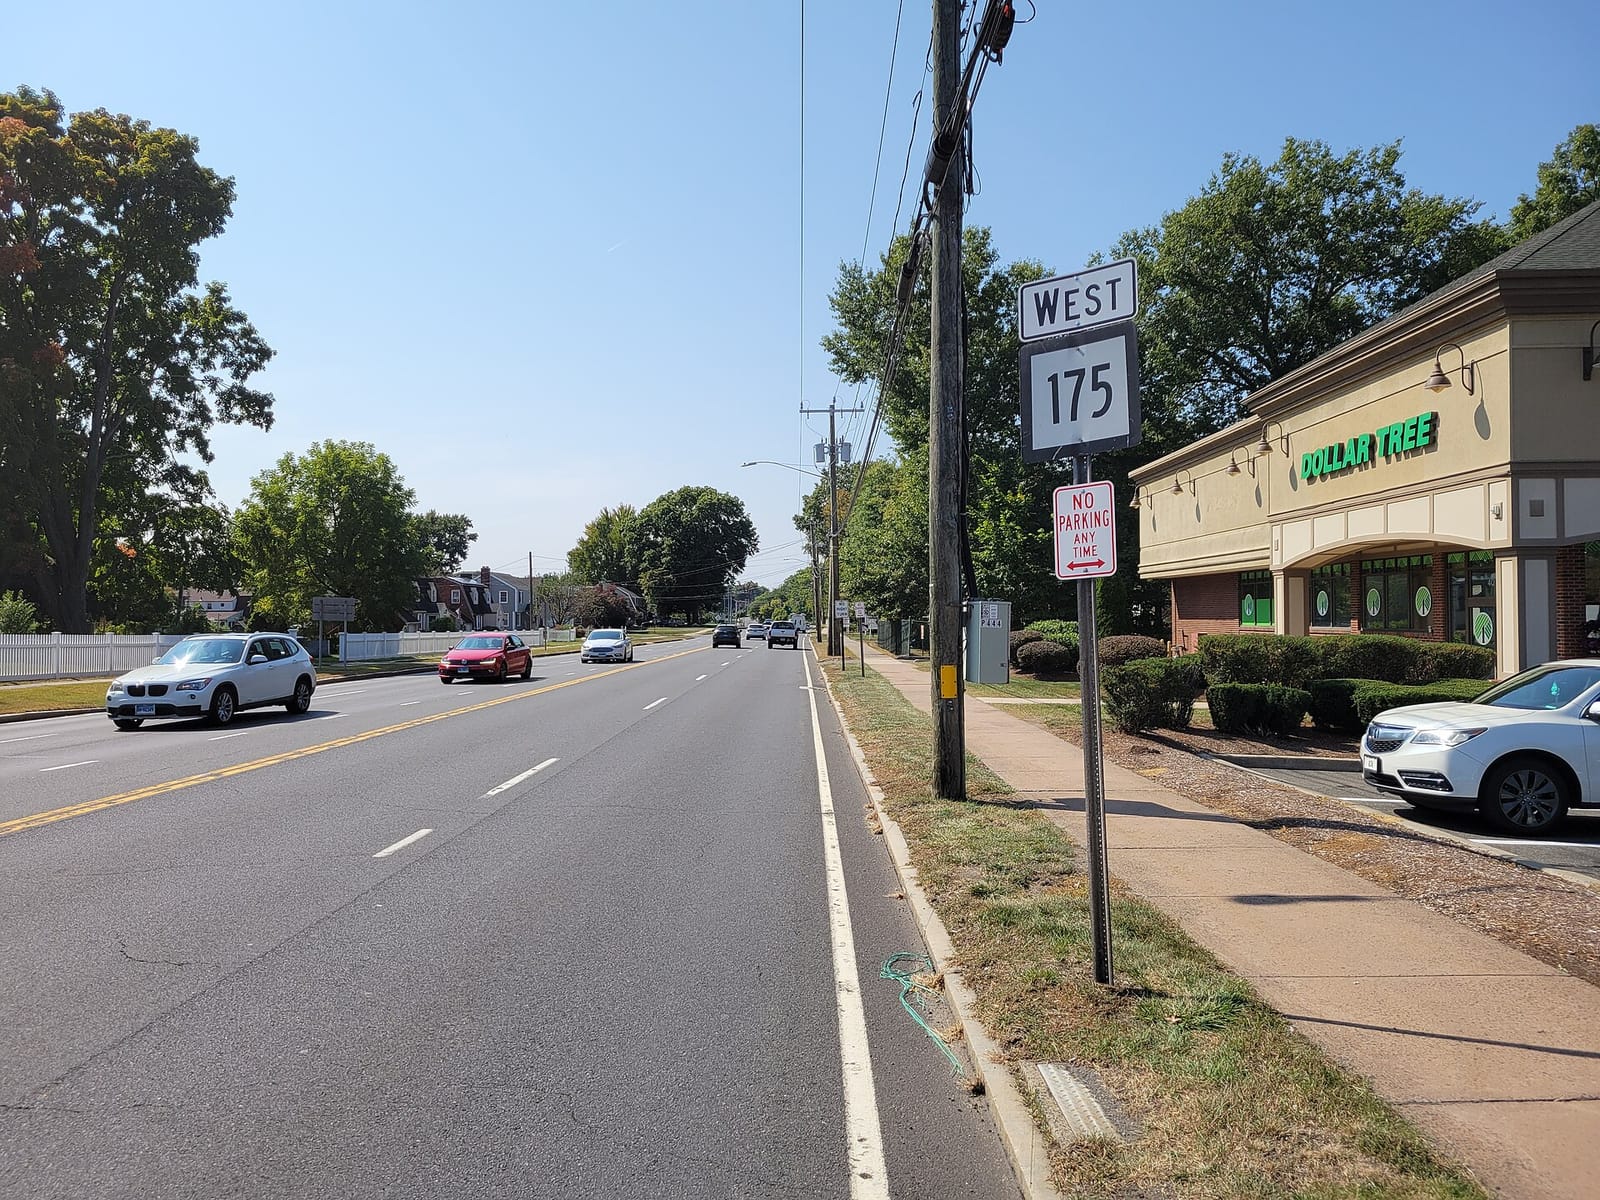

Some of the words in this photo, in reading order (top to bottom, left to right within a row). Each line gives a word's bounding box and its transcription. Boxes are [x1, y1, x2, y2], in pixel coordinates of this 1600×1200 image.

[1034, 277, 1122, 327] WEST
[1047, 362, 1113, 425] 175
[1301, 433, 1370, 480] DOLLAR
[1376, 411, 1432, 458] TREE
[1072, 492, 1094, 510] NO
[1059, 509, 1110, 532] PARKING
[1073, 531, 1096, 544] ANY
[1073, 544, 1098, 558] TIME
